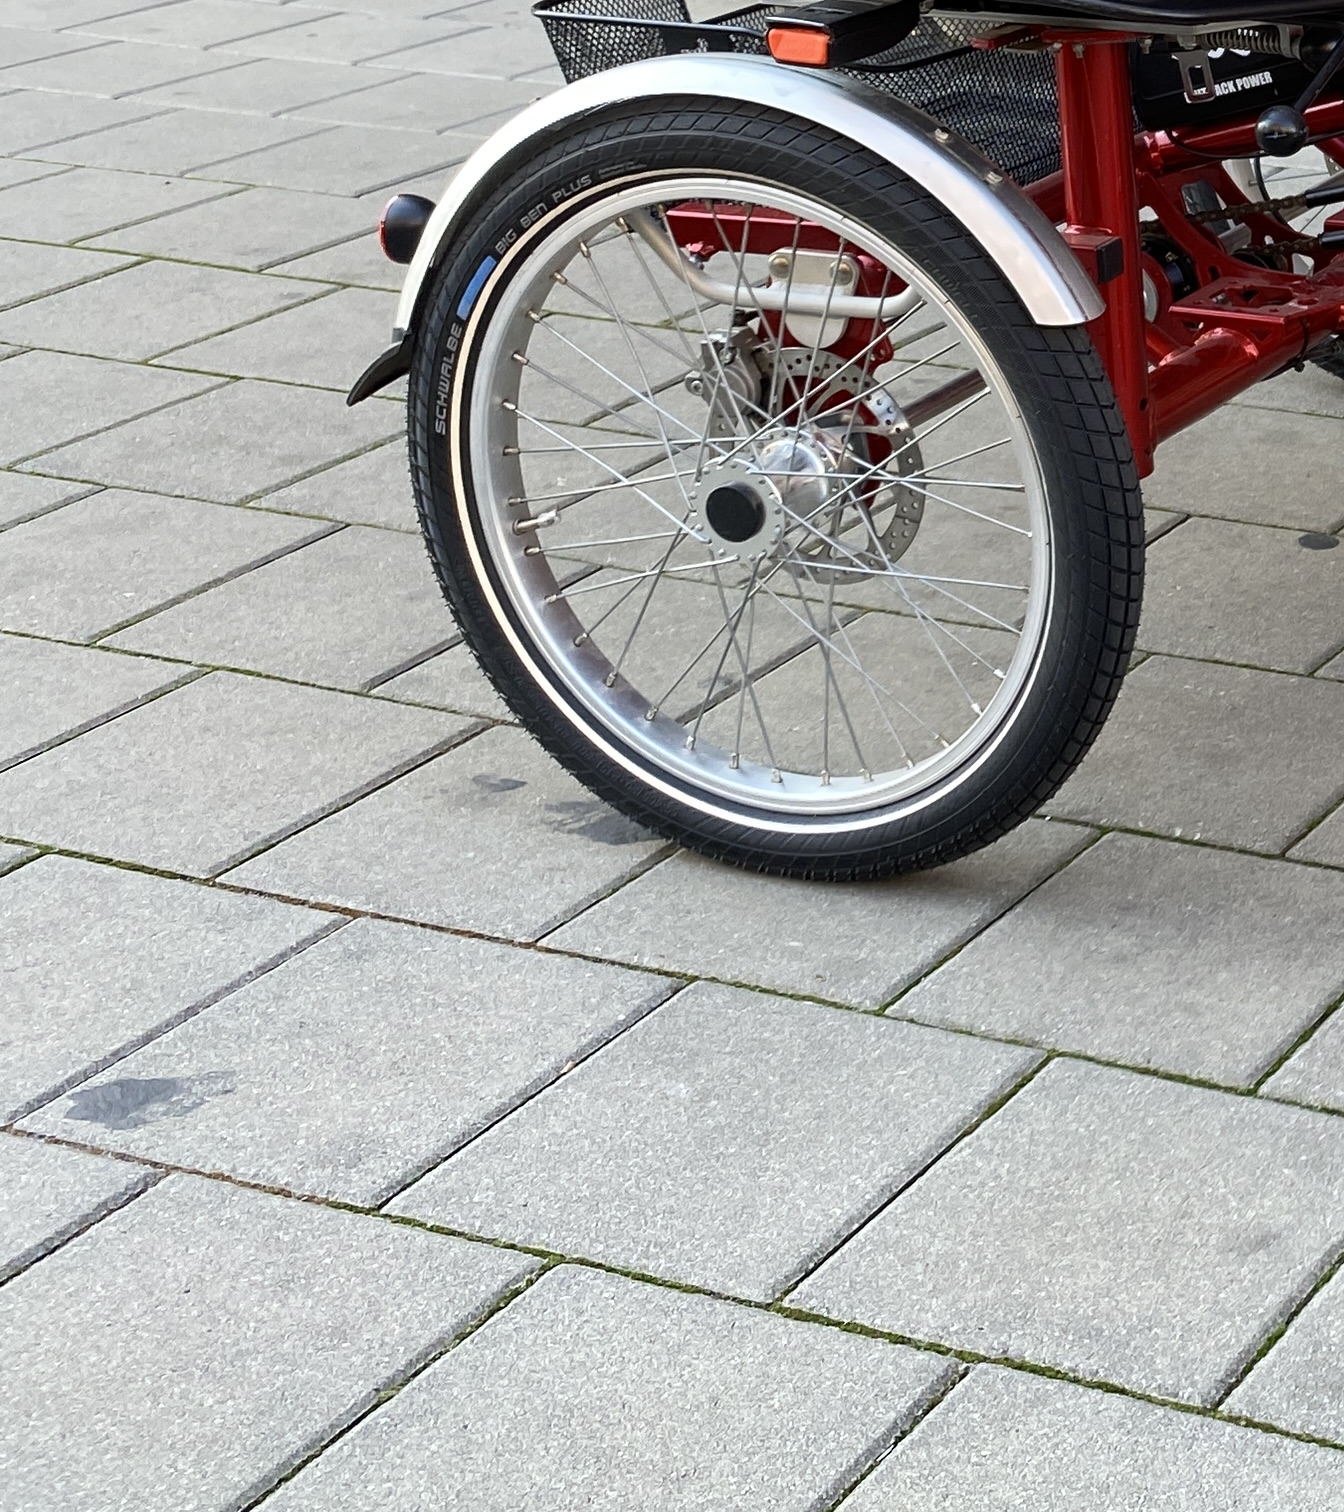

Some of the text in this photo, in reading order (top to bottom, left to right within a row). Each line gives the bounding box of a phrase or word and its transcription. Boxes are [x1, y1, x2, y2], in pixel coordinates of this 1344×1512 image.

[1235, 71, 1273, 92] POWER
[435, 322, 462, 436] SCHWALBE
[495, 227, 517, 255] BIG
[551, 174, 592, 203] PLUS
